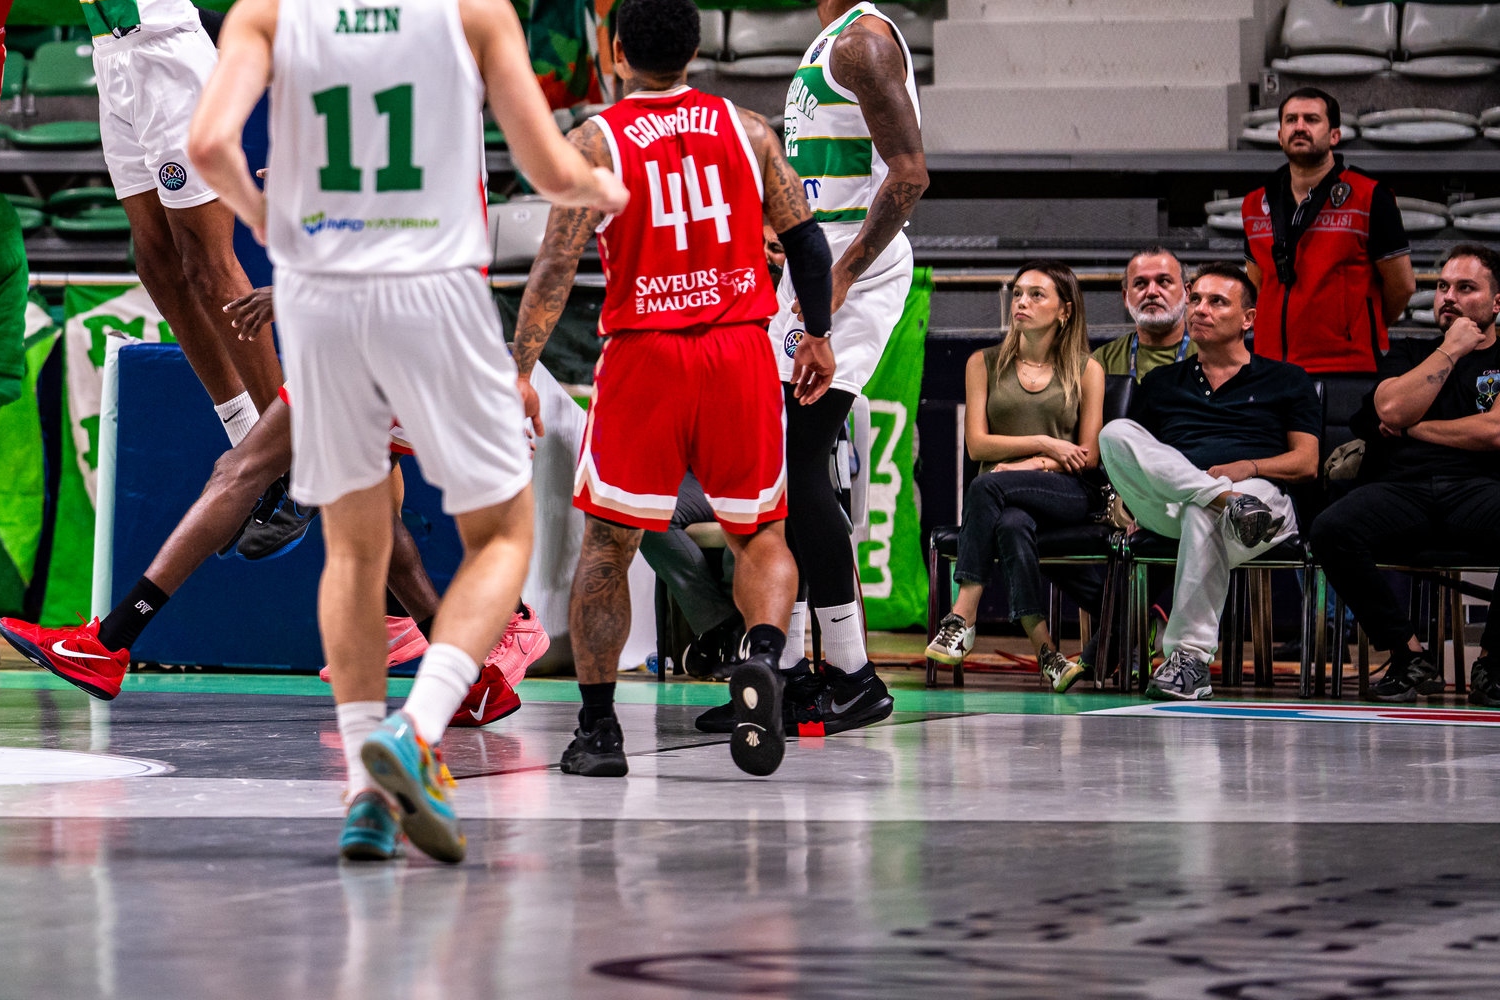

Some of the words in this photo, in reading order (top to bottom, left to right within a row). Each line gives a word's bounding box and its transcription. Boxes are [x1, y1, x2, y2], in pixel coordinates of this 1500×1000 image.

[311, 82, 424, 193] 11
[622, 105, 720, 149] CAMPBELL
[644, 154, 733, 252] 44
[635, 267, 719, 297] SAVEURS
[636, 297, 645, 315] DES
[646, 287, 722, 314] MAUGES
